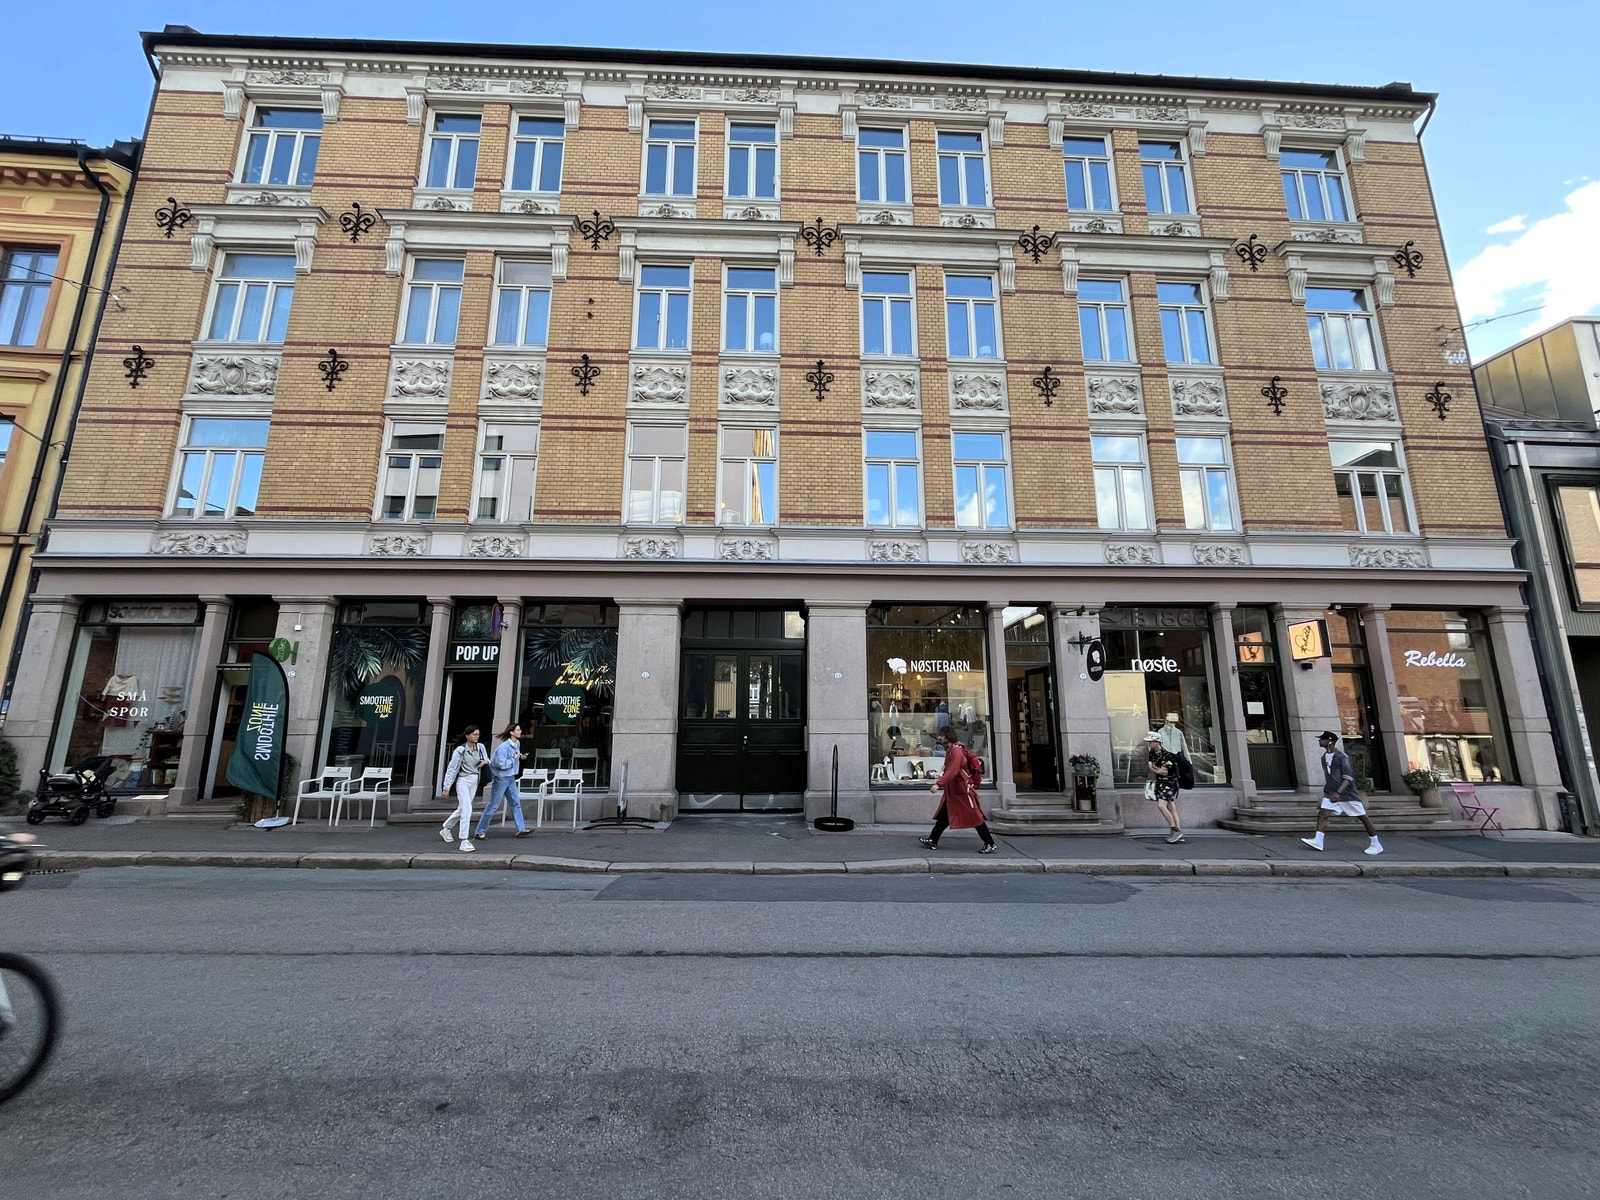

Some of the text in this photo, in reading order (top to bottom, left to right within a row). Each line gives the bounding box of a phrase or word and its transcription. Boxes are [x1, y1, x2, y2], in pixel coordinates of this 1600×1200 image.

[455, 645, 499, 661] POP UP
[1131, 656, 1181, 673] nøste.
[1404, 650, 1467, 668] Rebella
[910, 660, 970, 672] NØSTEBARN
[116, 689, 147, 701] SMÅ
[359, 695, 394, 705] SMOOTHIE
[548, 696, 582, 705] SMOOTHIE
[109, 706, 149, 717] SPOR
[374, 704, 393, 714] ZONE
[563, 704, 581, 714] ZONE
